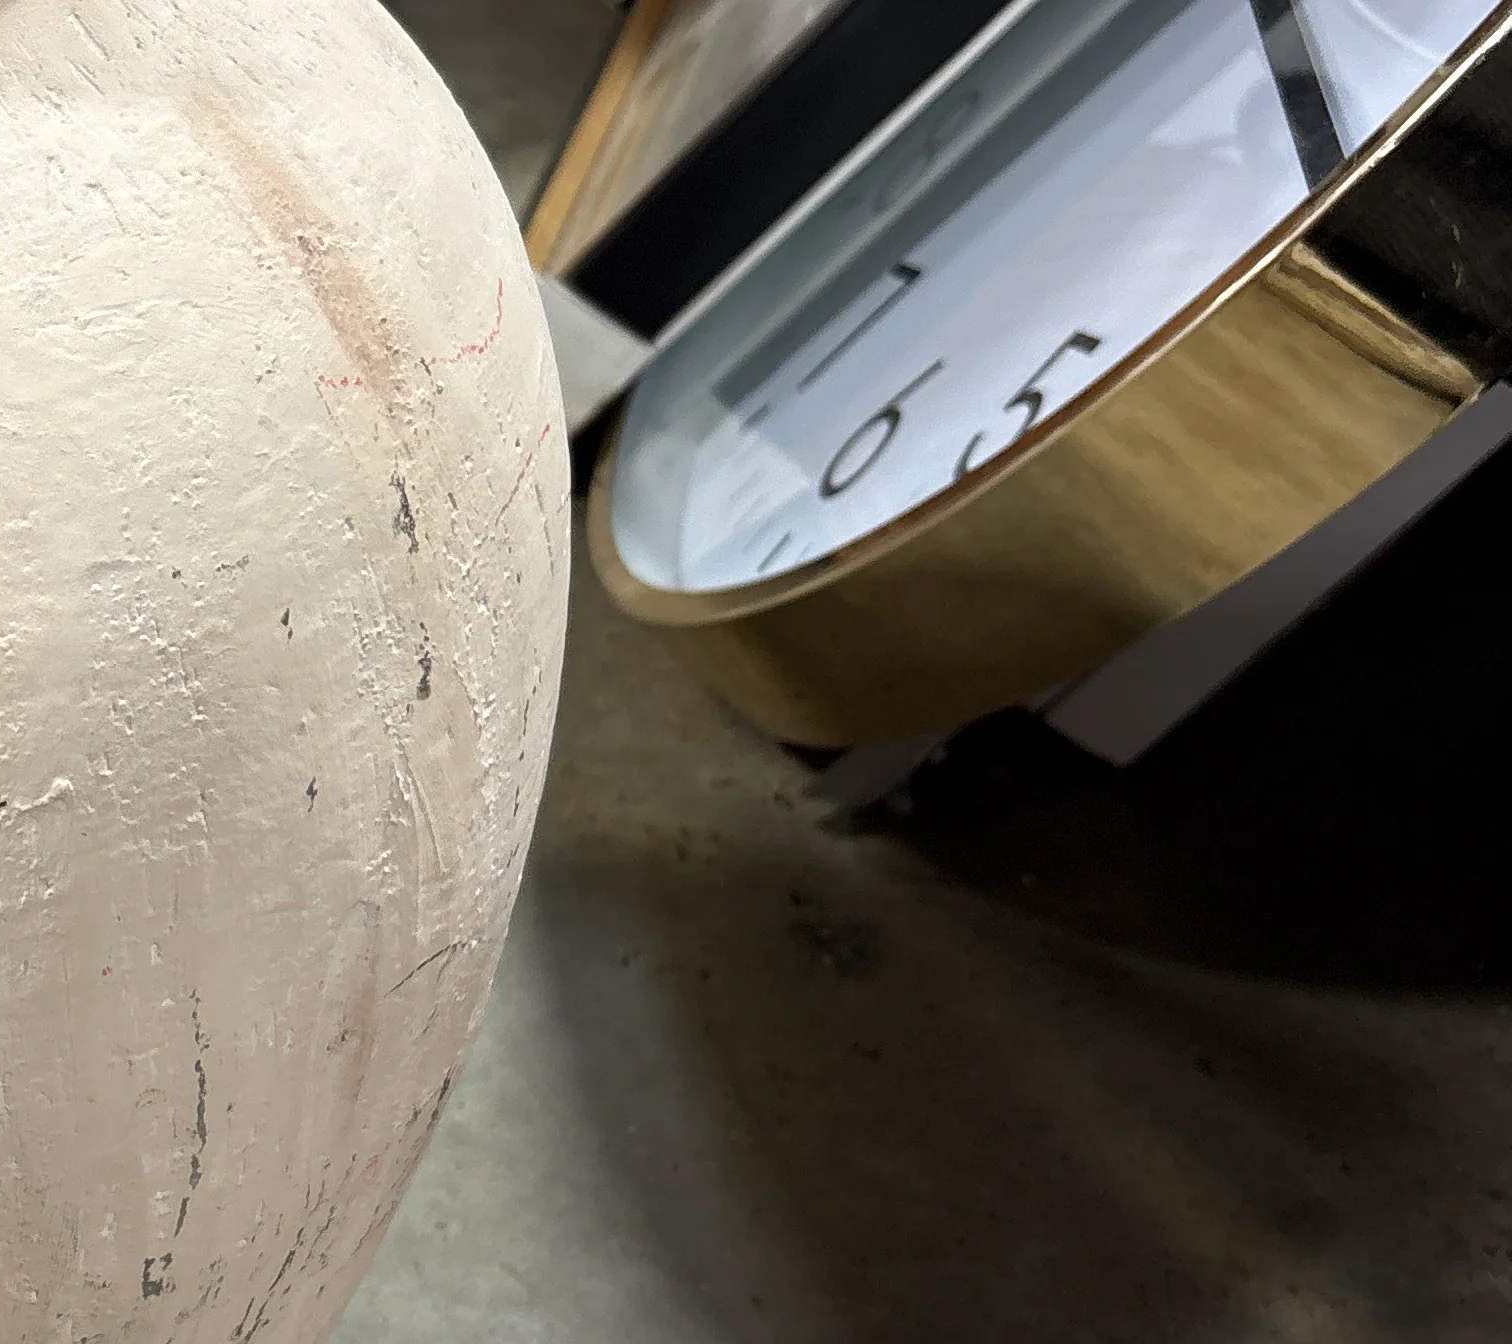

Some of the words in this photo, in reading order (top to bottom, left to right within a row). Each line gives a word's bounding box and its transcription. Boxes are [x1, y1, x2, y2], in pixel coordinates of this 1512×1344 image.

[798, 262, 922, 393] 7
[819, 358, 945, 499] 6
[953, 330, 1102, 480] 5
